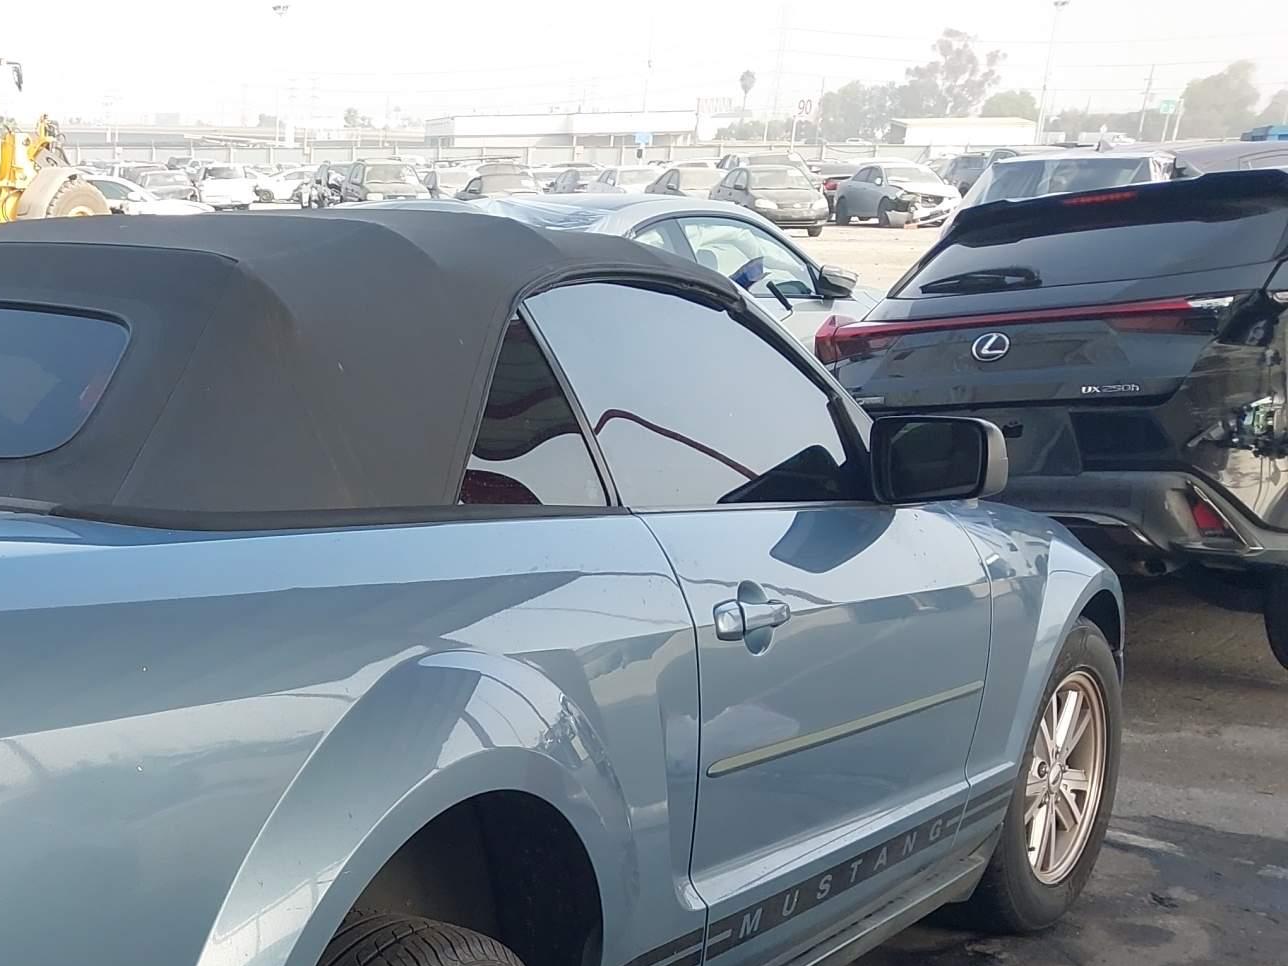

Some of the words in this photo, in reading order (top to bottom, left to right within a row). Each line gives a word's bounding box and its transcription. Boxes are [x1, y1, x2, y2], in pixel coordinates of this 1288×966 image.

[797, 99, 812, 115] 90
[1081, 386, 1101, 394] UX
[1102, 383, 1140, 393] 250h
[738, 818, 943, 939] MUSTANG
